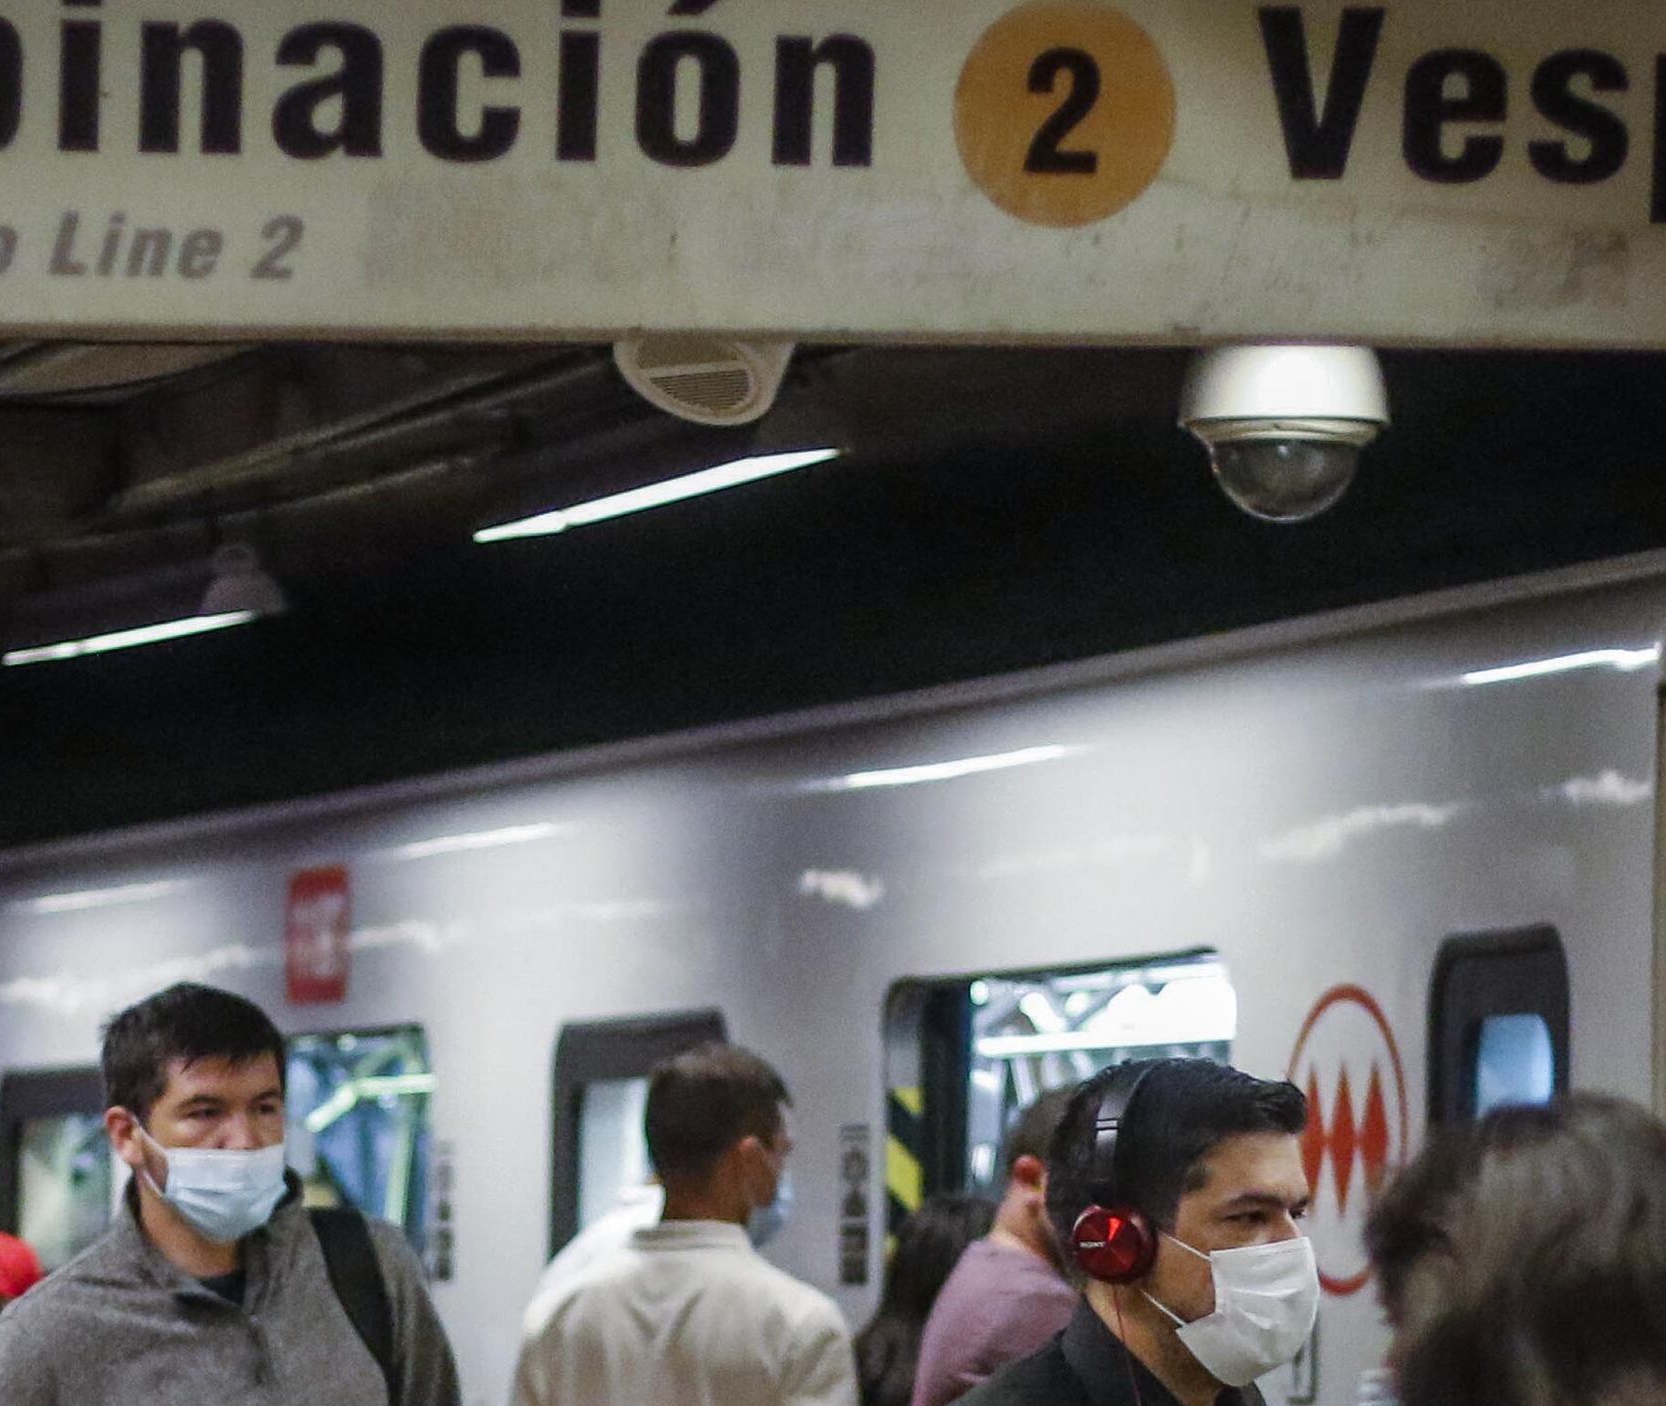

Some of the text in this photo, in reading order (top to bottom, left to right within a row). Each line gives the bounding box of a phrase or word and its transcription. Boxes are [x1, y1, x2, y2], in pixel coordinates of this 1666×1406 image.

[1023, 46, 1101, 174] 2
[47, 210, 225, 281] Line
[250, 214, 305, 281] 2
